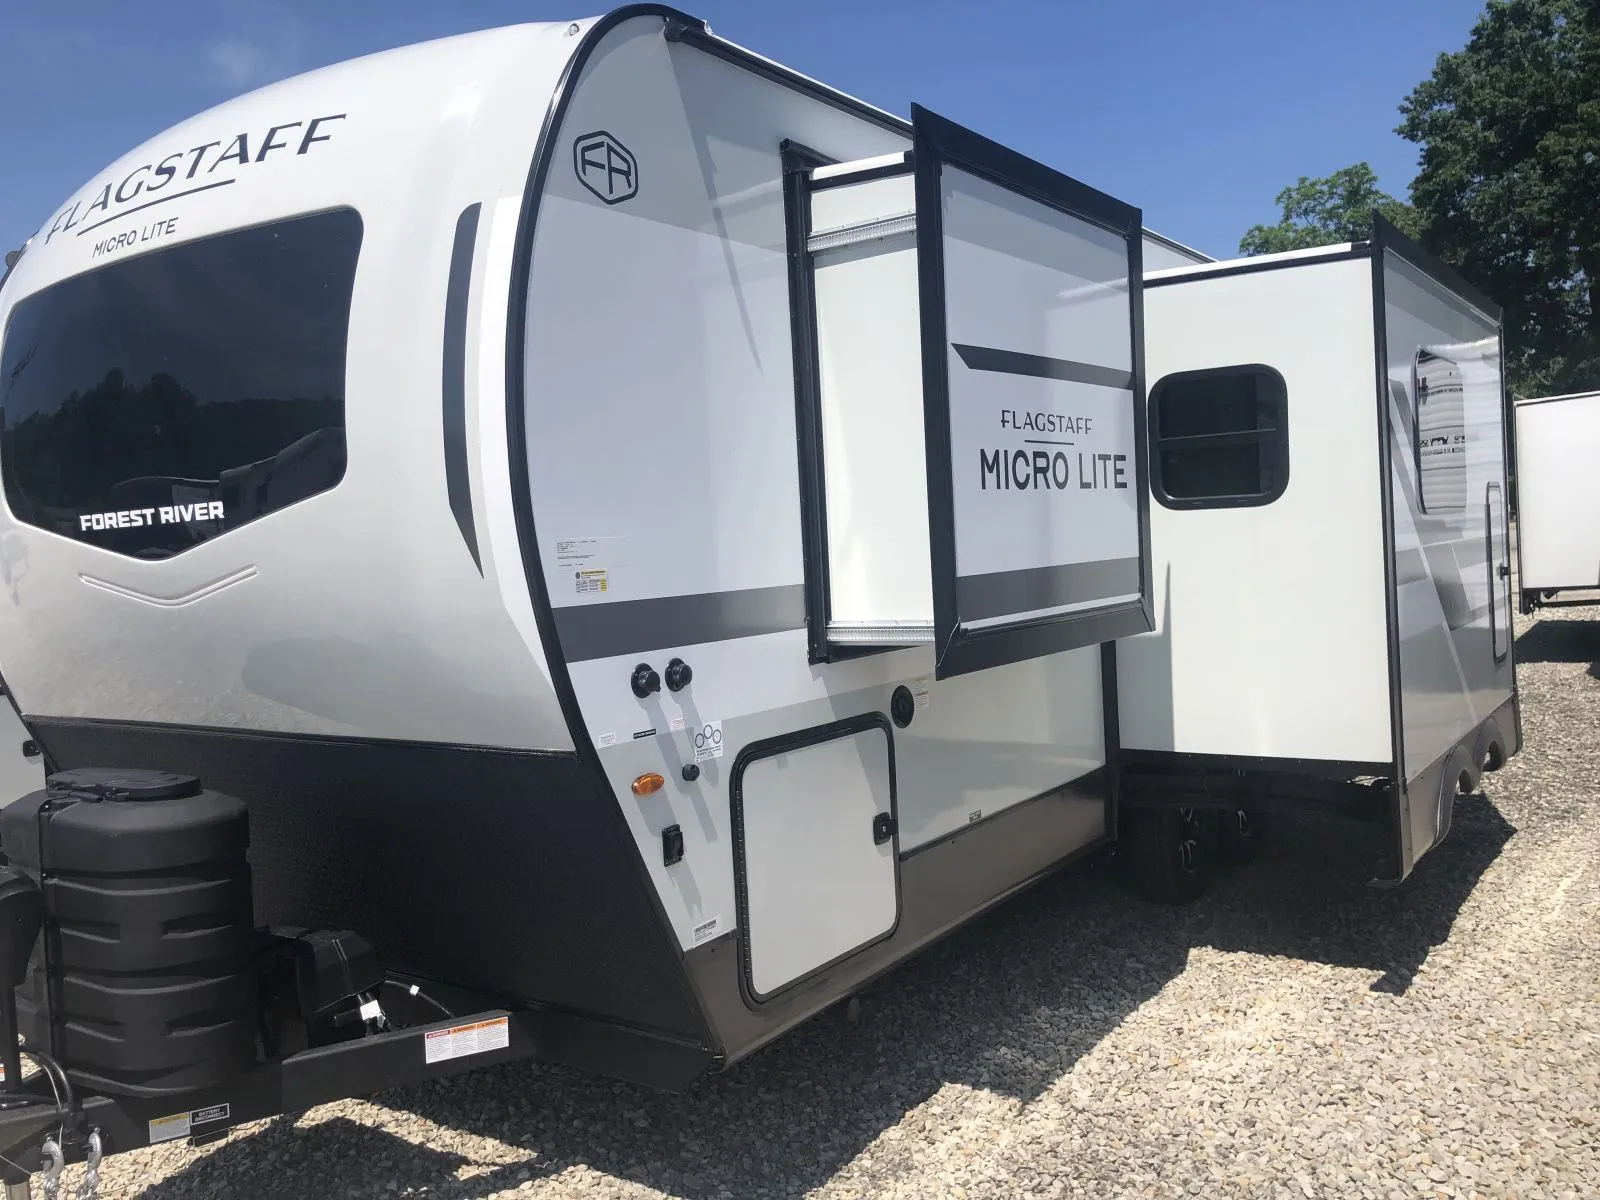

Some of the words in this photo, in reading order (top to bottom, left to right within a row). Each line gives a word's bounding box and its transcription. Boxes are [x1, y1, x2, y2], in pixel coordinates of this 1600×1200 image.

[44, 113, 347, 246] FLAGSTAFF
[92, 229, 137, 259] MICRO
[141, 216, 179, 242] LITE
[1000, 409, 1093, 435] FLAGSTAFF
[980, 448, 1069, 490] MICRO
[1078, 452, 1128, 490] LITE
[79, 508, 156, 531] FOREST
[158, 500, 225, 524] RIVER
